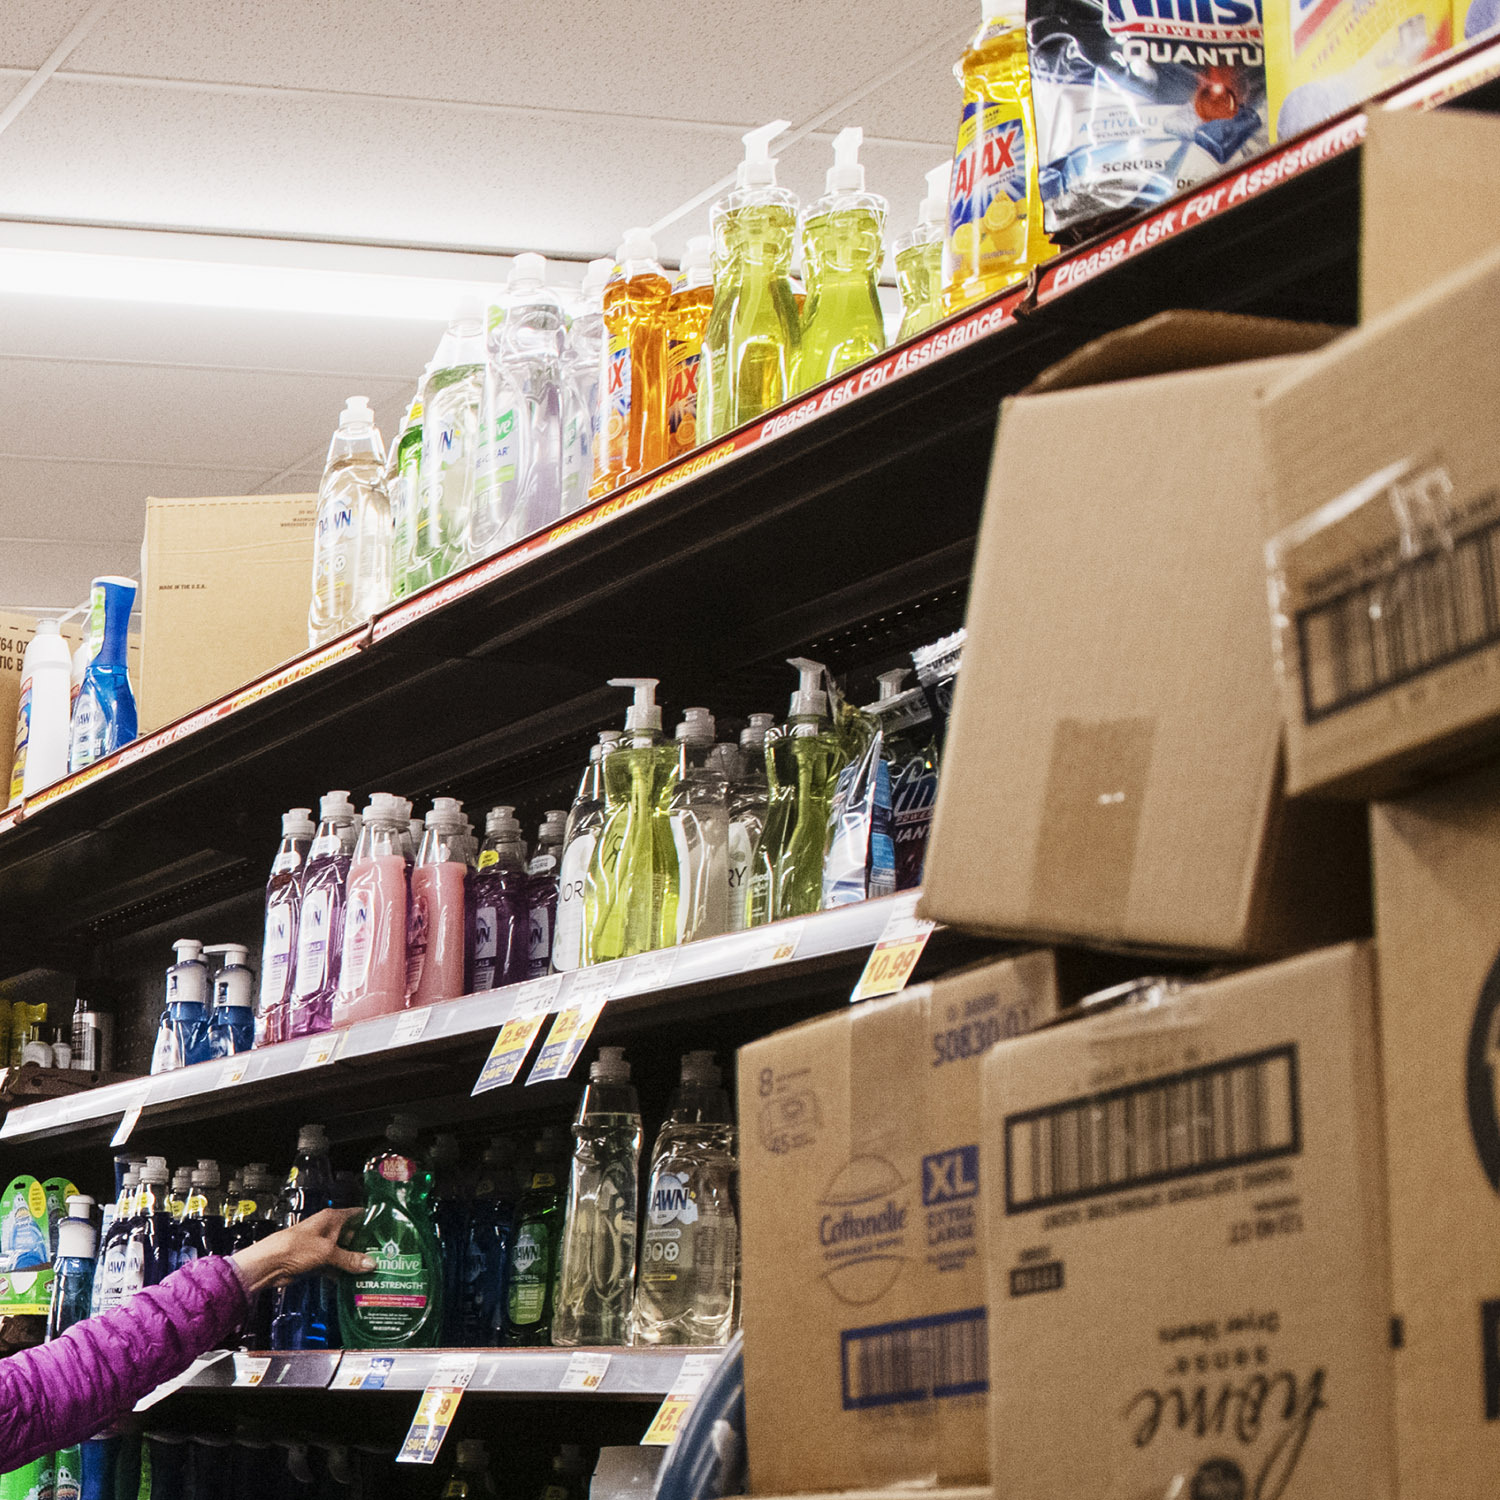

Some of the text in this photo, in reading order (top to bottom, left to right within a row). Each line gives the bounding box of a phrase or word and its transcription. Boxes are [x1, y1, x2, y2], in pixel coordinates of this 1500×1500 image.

[954, 130, 1016, 200] AJAX
[1054, 189, 1226, 291] Please Ask For
[760, 306, 1003, 439] Please Ask For Assistance
[548, 442, 736, 543] Please Ask For Assistance
[868, 949, 917, 982] 10.99
[500, 1022, 534, 1046] 2.99
[928, 1157, 978, 1200] XL
[819, 1203, 909, 1249] Cottonelle
[927, 1206, 977, 1229] EXTRA
[927, 1225, 976, 1247] LARGE
[355, 1280, 425, 1291] ULTRA STRENGTH
